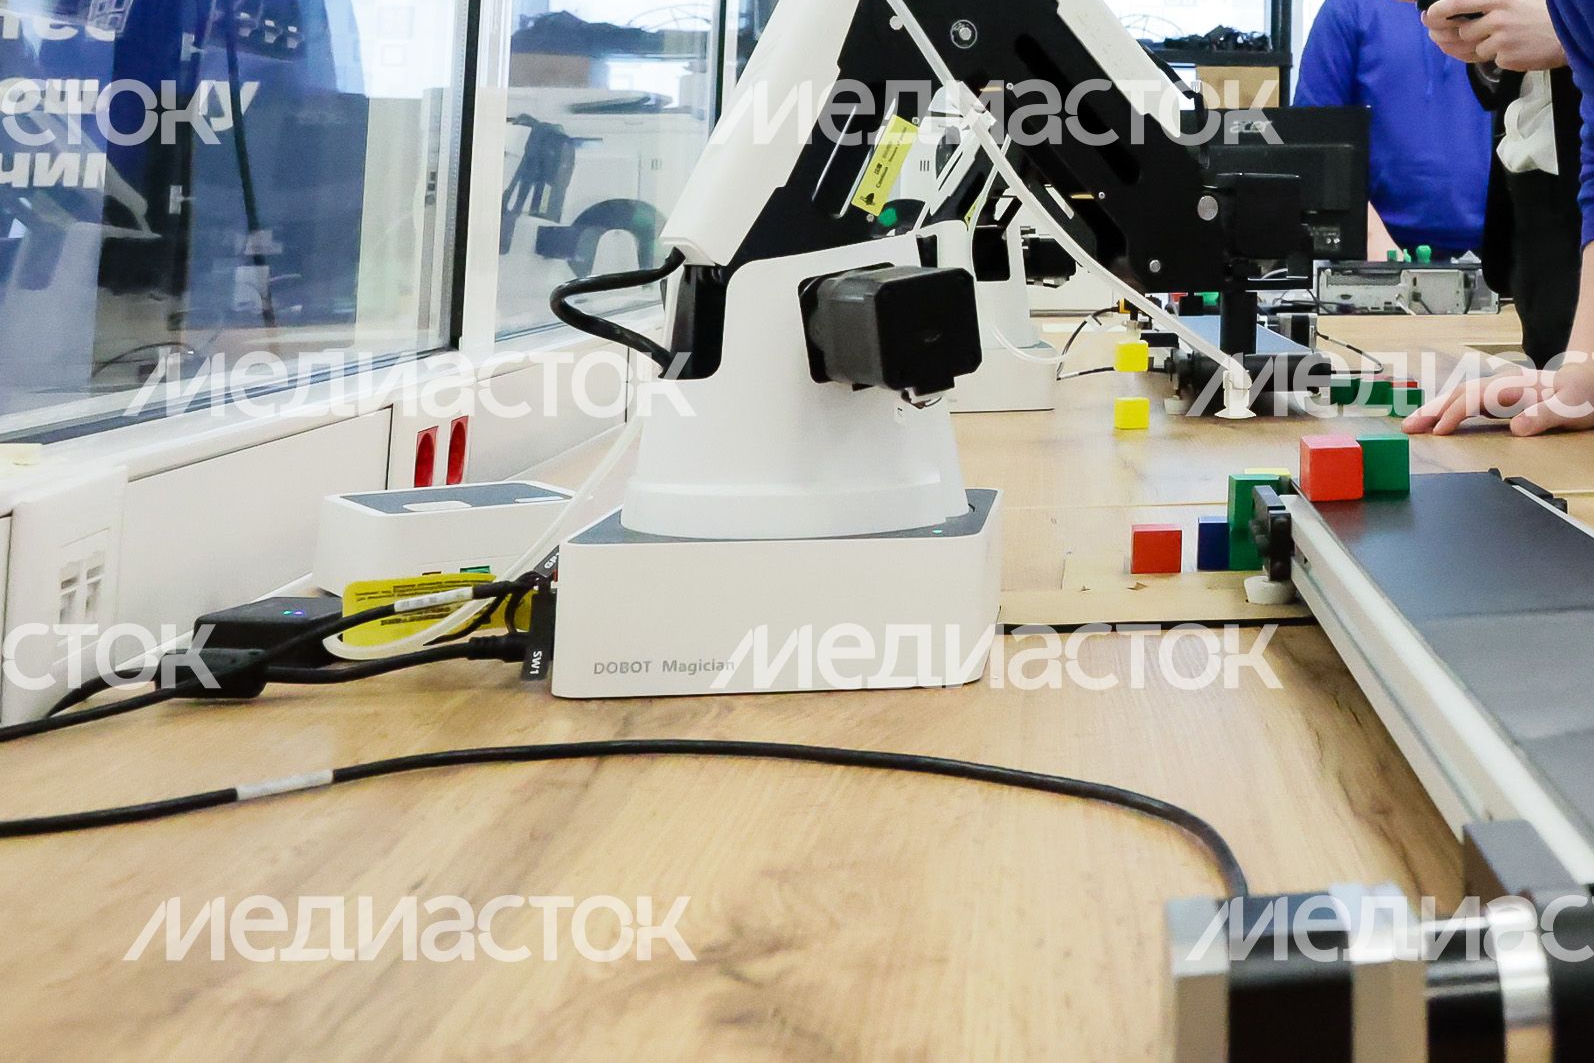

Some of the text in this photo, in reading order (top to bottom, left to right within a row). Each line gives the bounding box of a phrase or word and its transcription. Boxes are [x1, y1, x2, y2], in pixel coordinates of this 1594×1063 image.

[530, 650, 542, 675] SW1
[594, 658, 735, 676] DOBOT Magician
